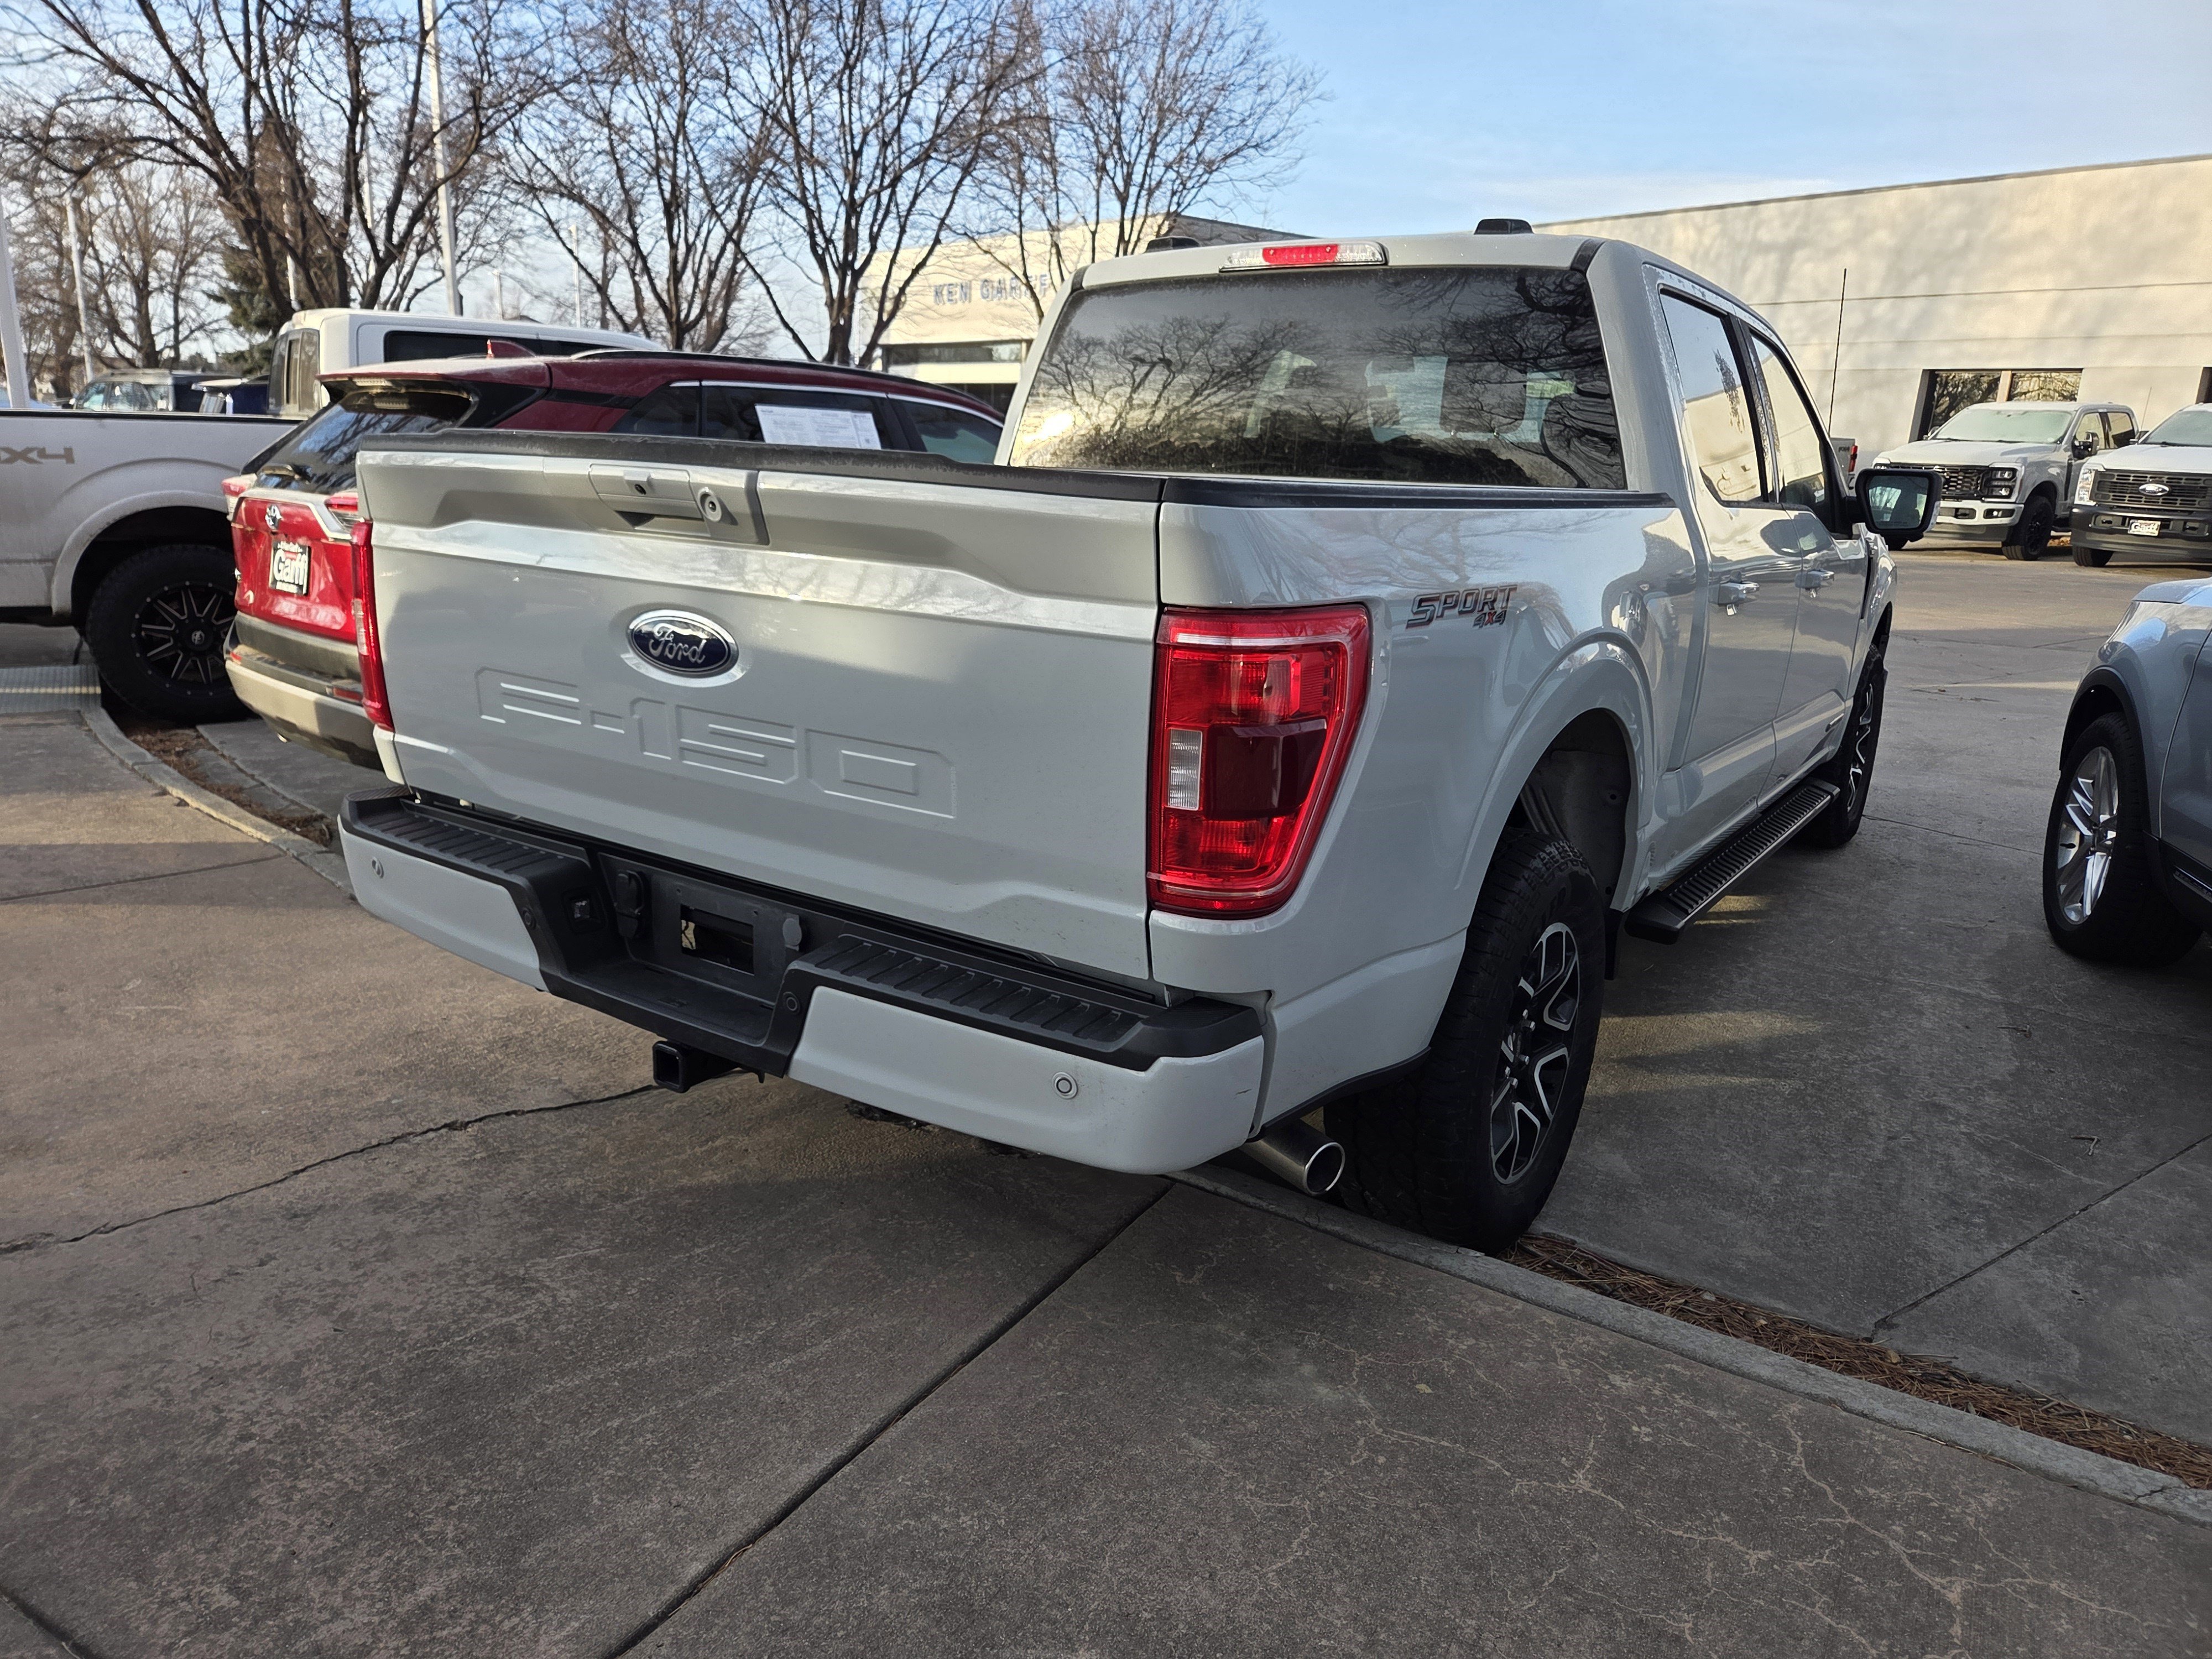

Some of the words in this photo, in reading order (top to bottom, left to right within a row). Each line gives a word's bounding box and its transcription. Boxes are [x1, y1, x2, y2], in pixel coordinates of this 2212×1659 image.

[933, 281, 972, 305] KEN
[0, 447, 75, 465] X4
[1405, 584, 1518, 630] SPORT
[649, 623, 709, 664] Ford
[474, 667, 957, 819] F-150
